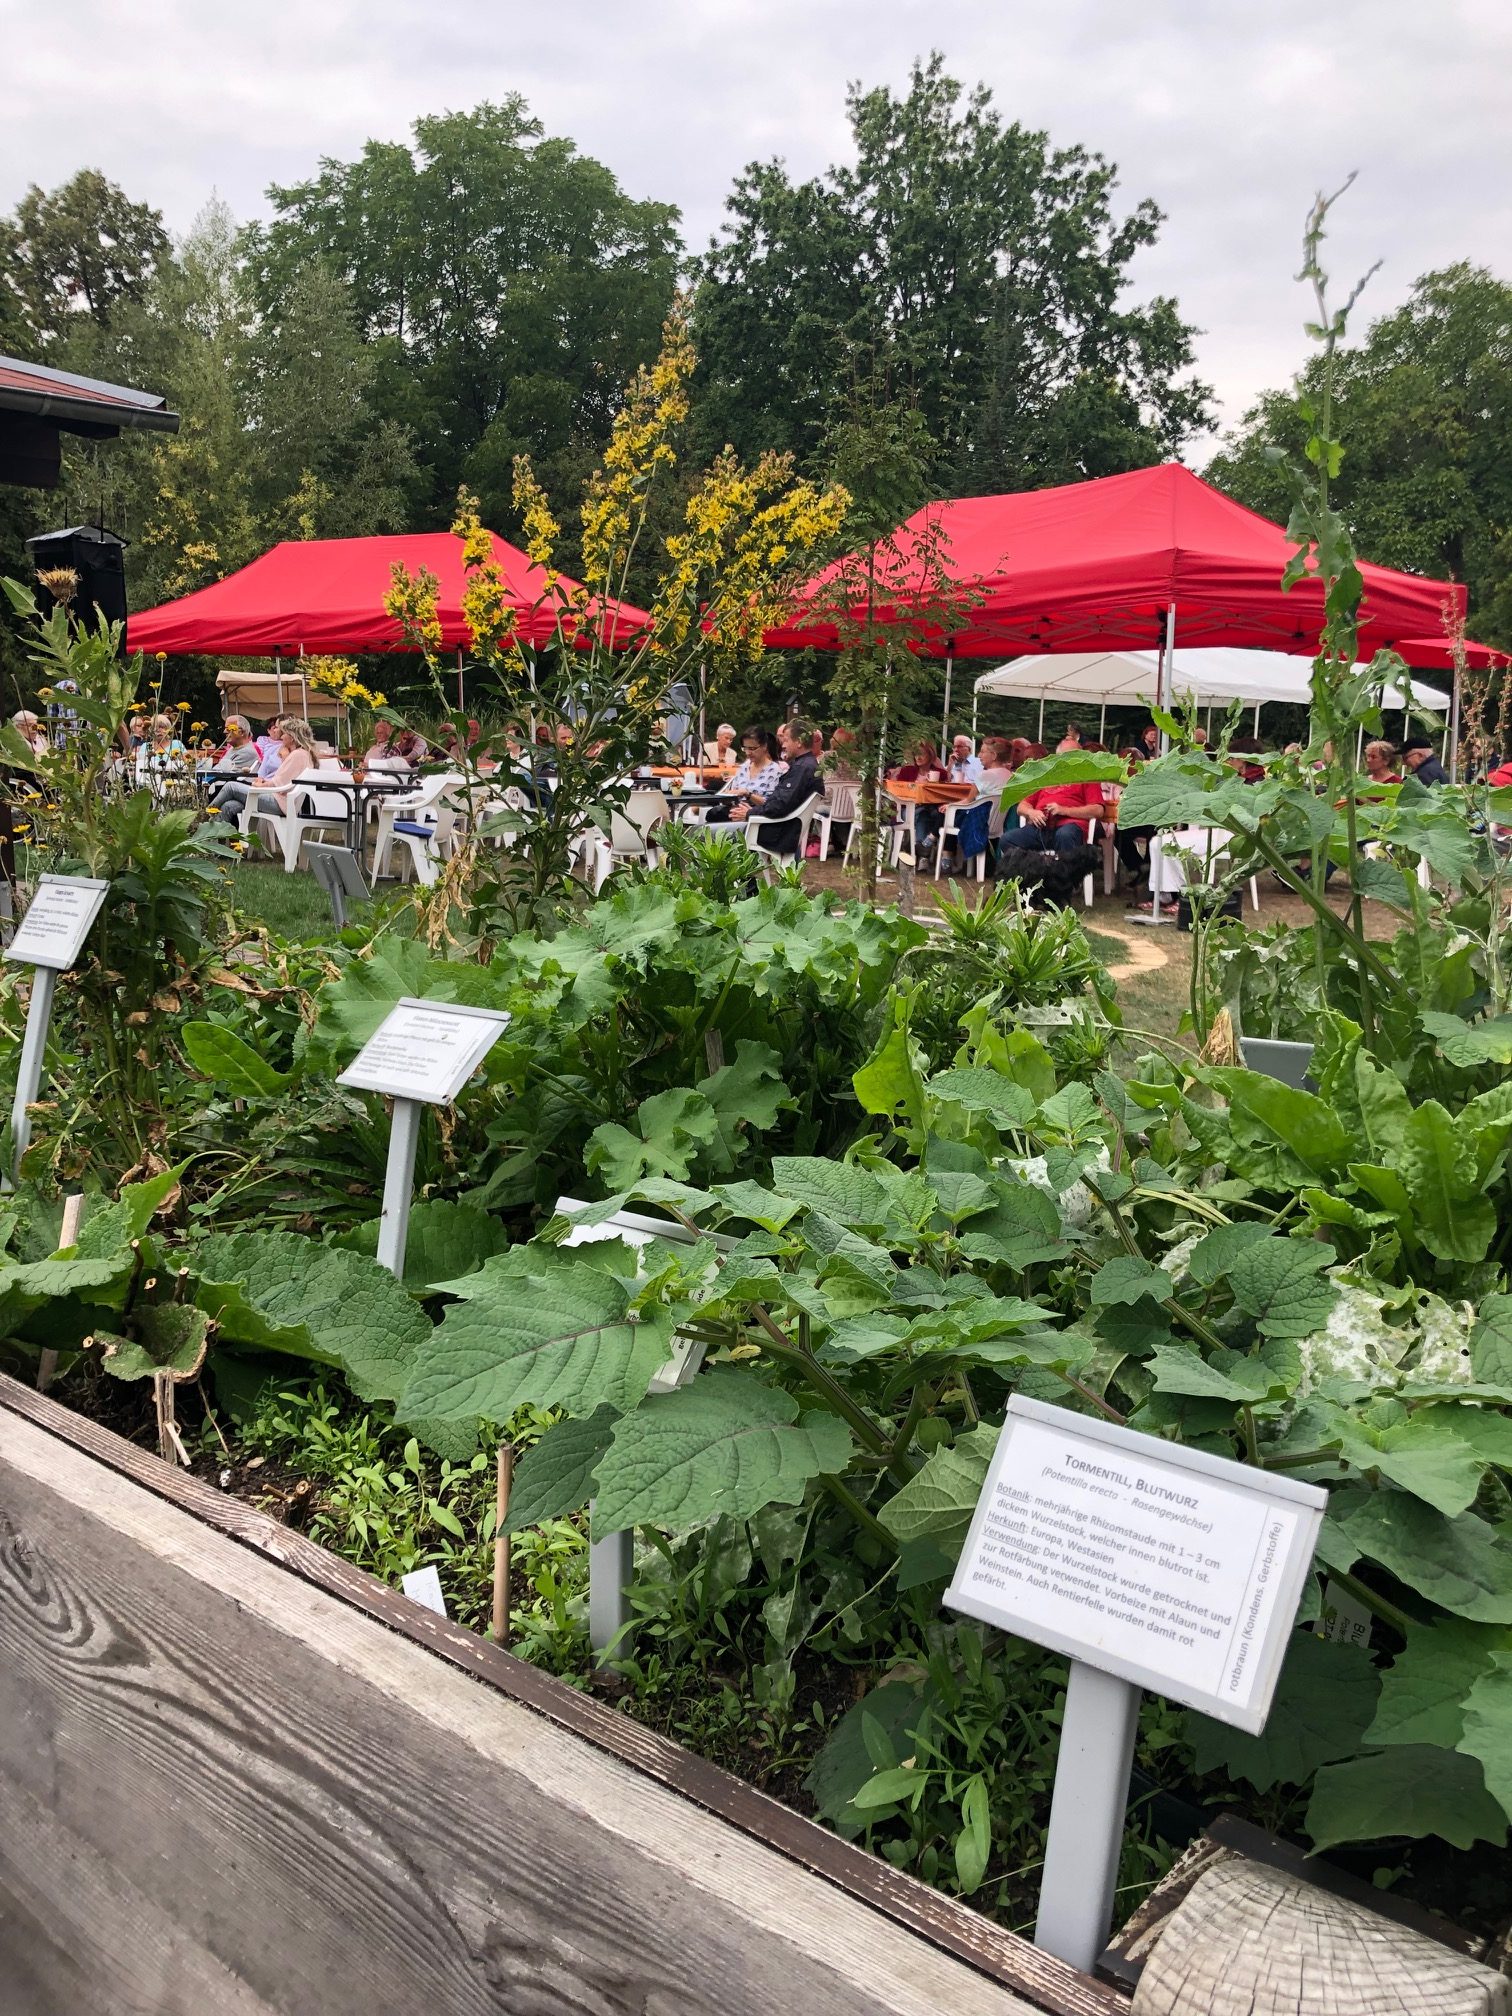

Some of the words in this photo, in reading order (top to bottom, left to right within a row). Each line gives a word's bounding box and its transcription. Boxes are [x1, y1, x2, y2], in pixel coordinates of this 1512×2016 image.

[1041, 1466, 1088, 1490] (Potentilla
[1089, 1483, 1119, 1500] erecta
[1131, 1497, 1214, 1534] Rosengewächse)
[1065, 1454, 1132, 1489] TORMENTILL,
[1135, 1478, 1200, 1510] BLUTWURZ
[987, 1510, 1029, 1534] Herkunft:
[1030, 1526, 1064, 1548] Europa,
[1067, 1539, 1114, 1565] Westasien
[996, 1482, 1033, 1503] Botanik:
[1034, 1497, 1088, 1522] mehrjährige
[1090, 1515, 1157, 1547] Rhizomstaude
[1158, 1541, 1176, 1554] mit
[1178, 1547, 1184, 1557] 1
[1195, 1553, 1203, 1563] 3
[1204, 1558, 1220, 1570] cm
[997, 1498, 1028, 1516] dickem
[1031, 1510, 1086, 1539] Wurzelstock,
[1089, 1533, 1126, 1552] welcher
[1128, 1545, 1156, 1563] innen
[1158, 1556, 1194, 1577] blutrot
[1195, 1570, 1210, 1584] ist.
[972, 1571, 1007, 1591] gefärbt.
[979, 1555, 1024, 1581] Weinstein.
[1025, 1574, 1050, 1591] Auch
[1051, 1584, 1105, 1613] Rentierfelle
[1107, 1607, 1145, 1628] wurden
[1146, 1622, 1177, 1641] damit
[1178, 1636, 1195, 1648] rot
[982, 1524, 1041, 1555] Verwendung:
[1042, 1547, 1060, 1560] Der
[1061, 1554, 1118, 1582] Wurzelstock
[1120, 1577, 1152, 1596] wurde
[1152, 1590, 1209, 1618] getrocknet
[1210, 1611, 1232, 1626] und
[982, 1542, 998, 1553] zur
[999, 1546, 1049, 1575] Rotfärbung
[1050, 1568, 1101, 1594] verwendet.
[1105, 1586, 1147, 1611] Vorbeize
[1148, 1605, 1166, 1619] mit
[1167, 1612, 1198, 1631] Alaun
[1200, 1626, 1221, 1640] und
[1229, 1642, 1249, 1692] rotbraun
[1242, 1587, 1265, 1639] (Kondens.
[1258, 1522, 1284, 1583] Gerbstoffe)
